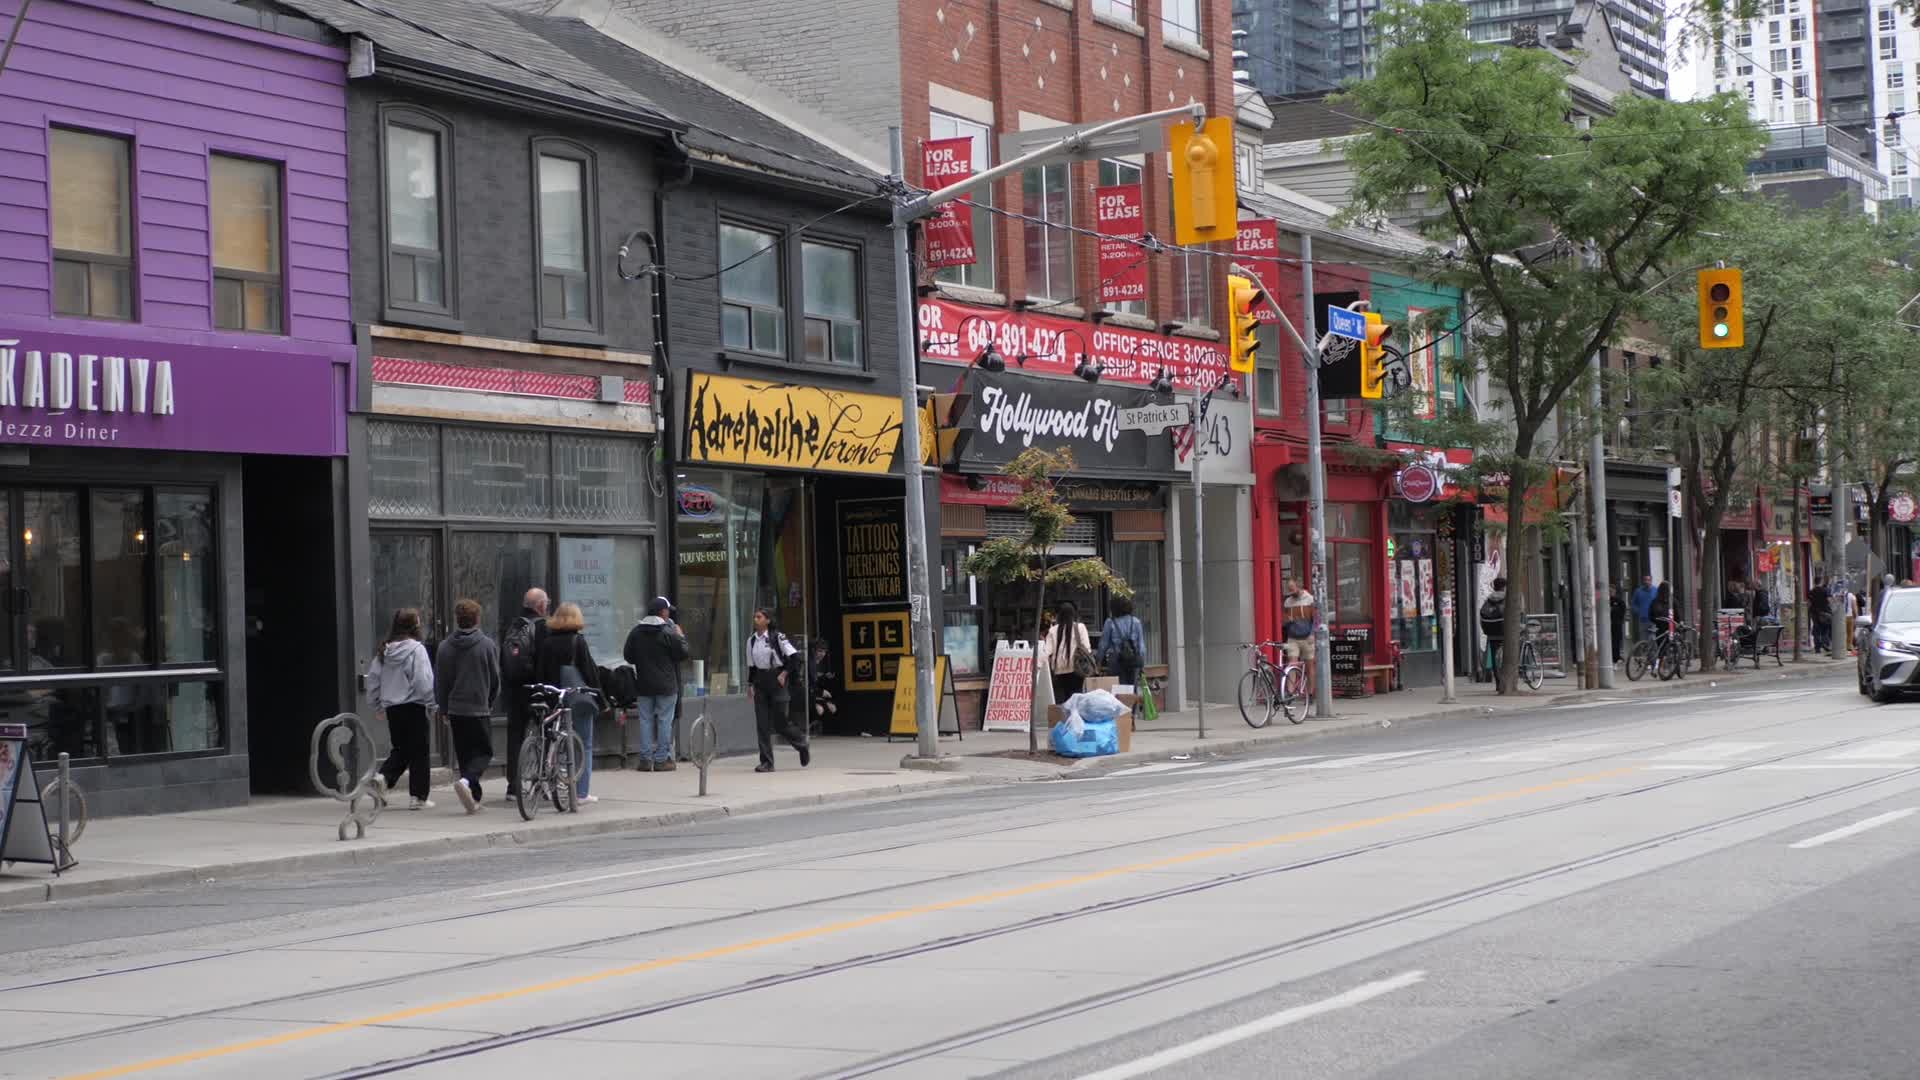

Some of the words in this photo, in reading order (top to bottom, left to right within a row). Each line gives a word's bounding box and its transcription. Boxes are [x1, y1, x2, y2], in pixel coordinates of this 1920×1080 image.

[926, 149, 954, 163] FOR
[926, 160, 968, 177] LEASE
[1099, 195, 1126, 209] FOR
[1100, 206, 1140, 221] LEASE
[1236, 228, 1261, 241] FOR
[1101, 242, 1128, 252] RETAIL
[1237, 238, 1274, 252] LEASE
[930, 247, 973, 262] 891-4224
[1103, 283, 1143, 298] 891-4224
[919, 303, 943, 330] OR
[919, 329, 960, 357] EASE
[968, 318, 1067, 364] 647-891-4224
[1093, 330, 1138, 356] OFFICE
[1141, 338, 1180, 361] SPACE
[1183, 343, 1216, 364] 3,000
[1074, 352, 1137, 378] FAGSHIP
[1183, 367, 1216, 388] 3,200
[690, 376, 821, 463] Adrenaline
[981, 386, 1090, 447] Hollywood
[1127, 412, 1136, 425] St
[1137, 409, 1168, 424] Patrick
[1170, 408, 1179, 421] St
[0, 420, 53, 439] ezza
[65, 422, 119, 441] Diner
[847, 523, 899, 552] TATTOOS
[847, 551, 900, 578] PIERCINGS
[847, 577, 901, 598] STREETWEAR
[990, 685, 1033, 700] ITALIAN
[986, 709, 1030, 721] ESPRESSO
